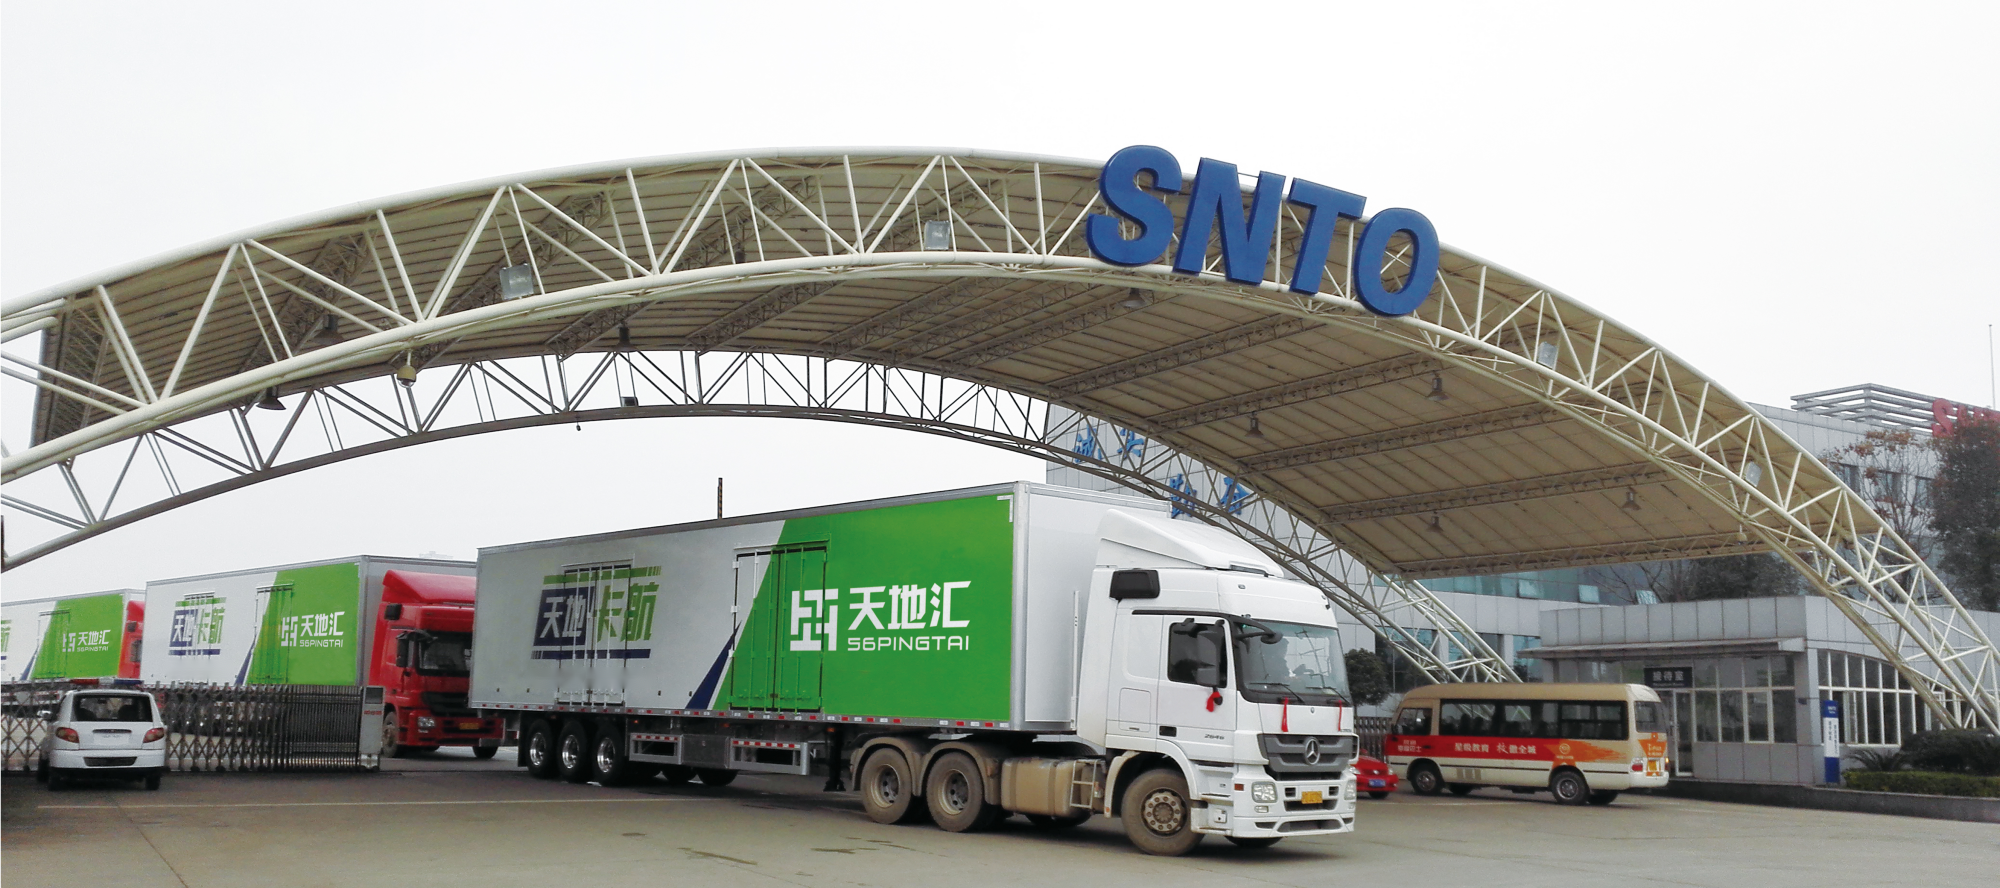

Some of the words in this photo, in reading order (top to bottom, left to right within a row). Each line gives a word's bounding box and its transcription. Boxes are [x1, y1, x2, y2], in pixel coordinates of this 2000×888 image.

[1086, 144, 1440, 317] SNTO
[848, 581, 971, 630] 天地汇
[300, 611, 345, 637] 天地汇
[78, 630, 111, 645] 天地汇
[848, 635, 969, 651] 56PINGTAI
